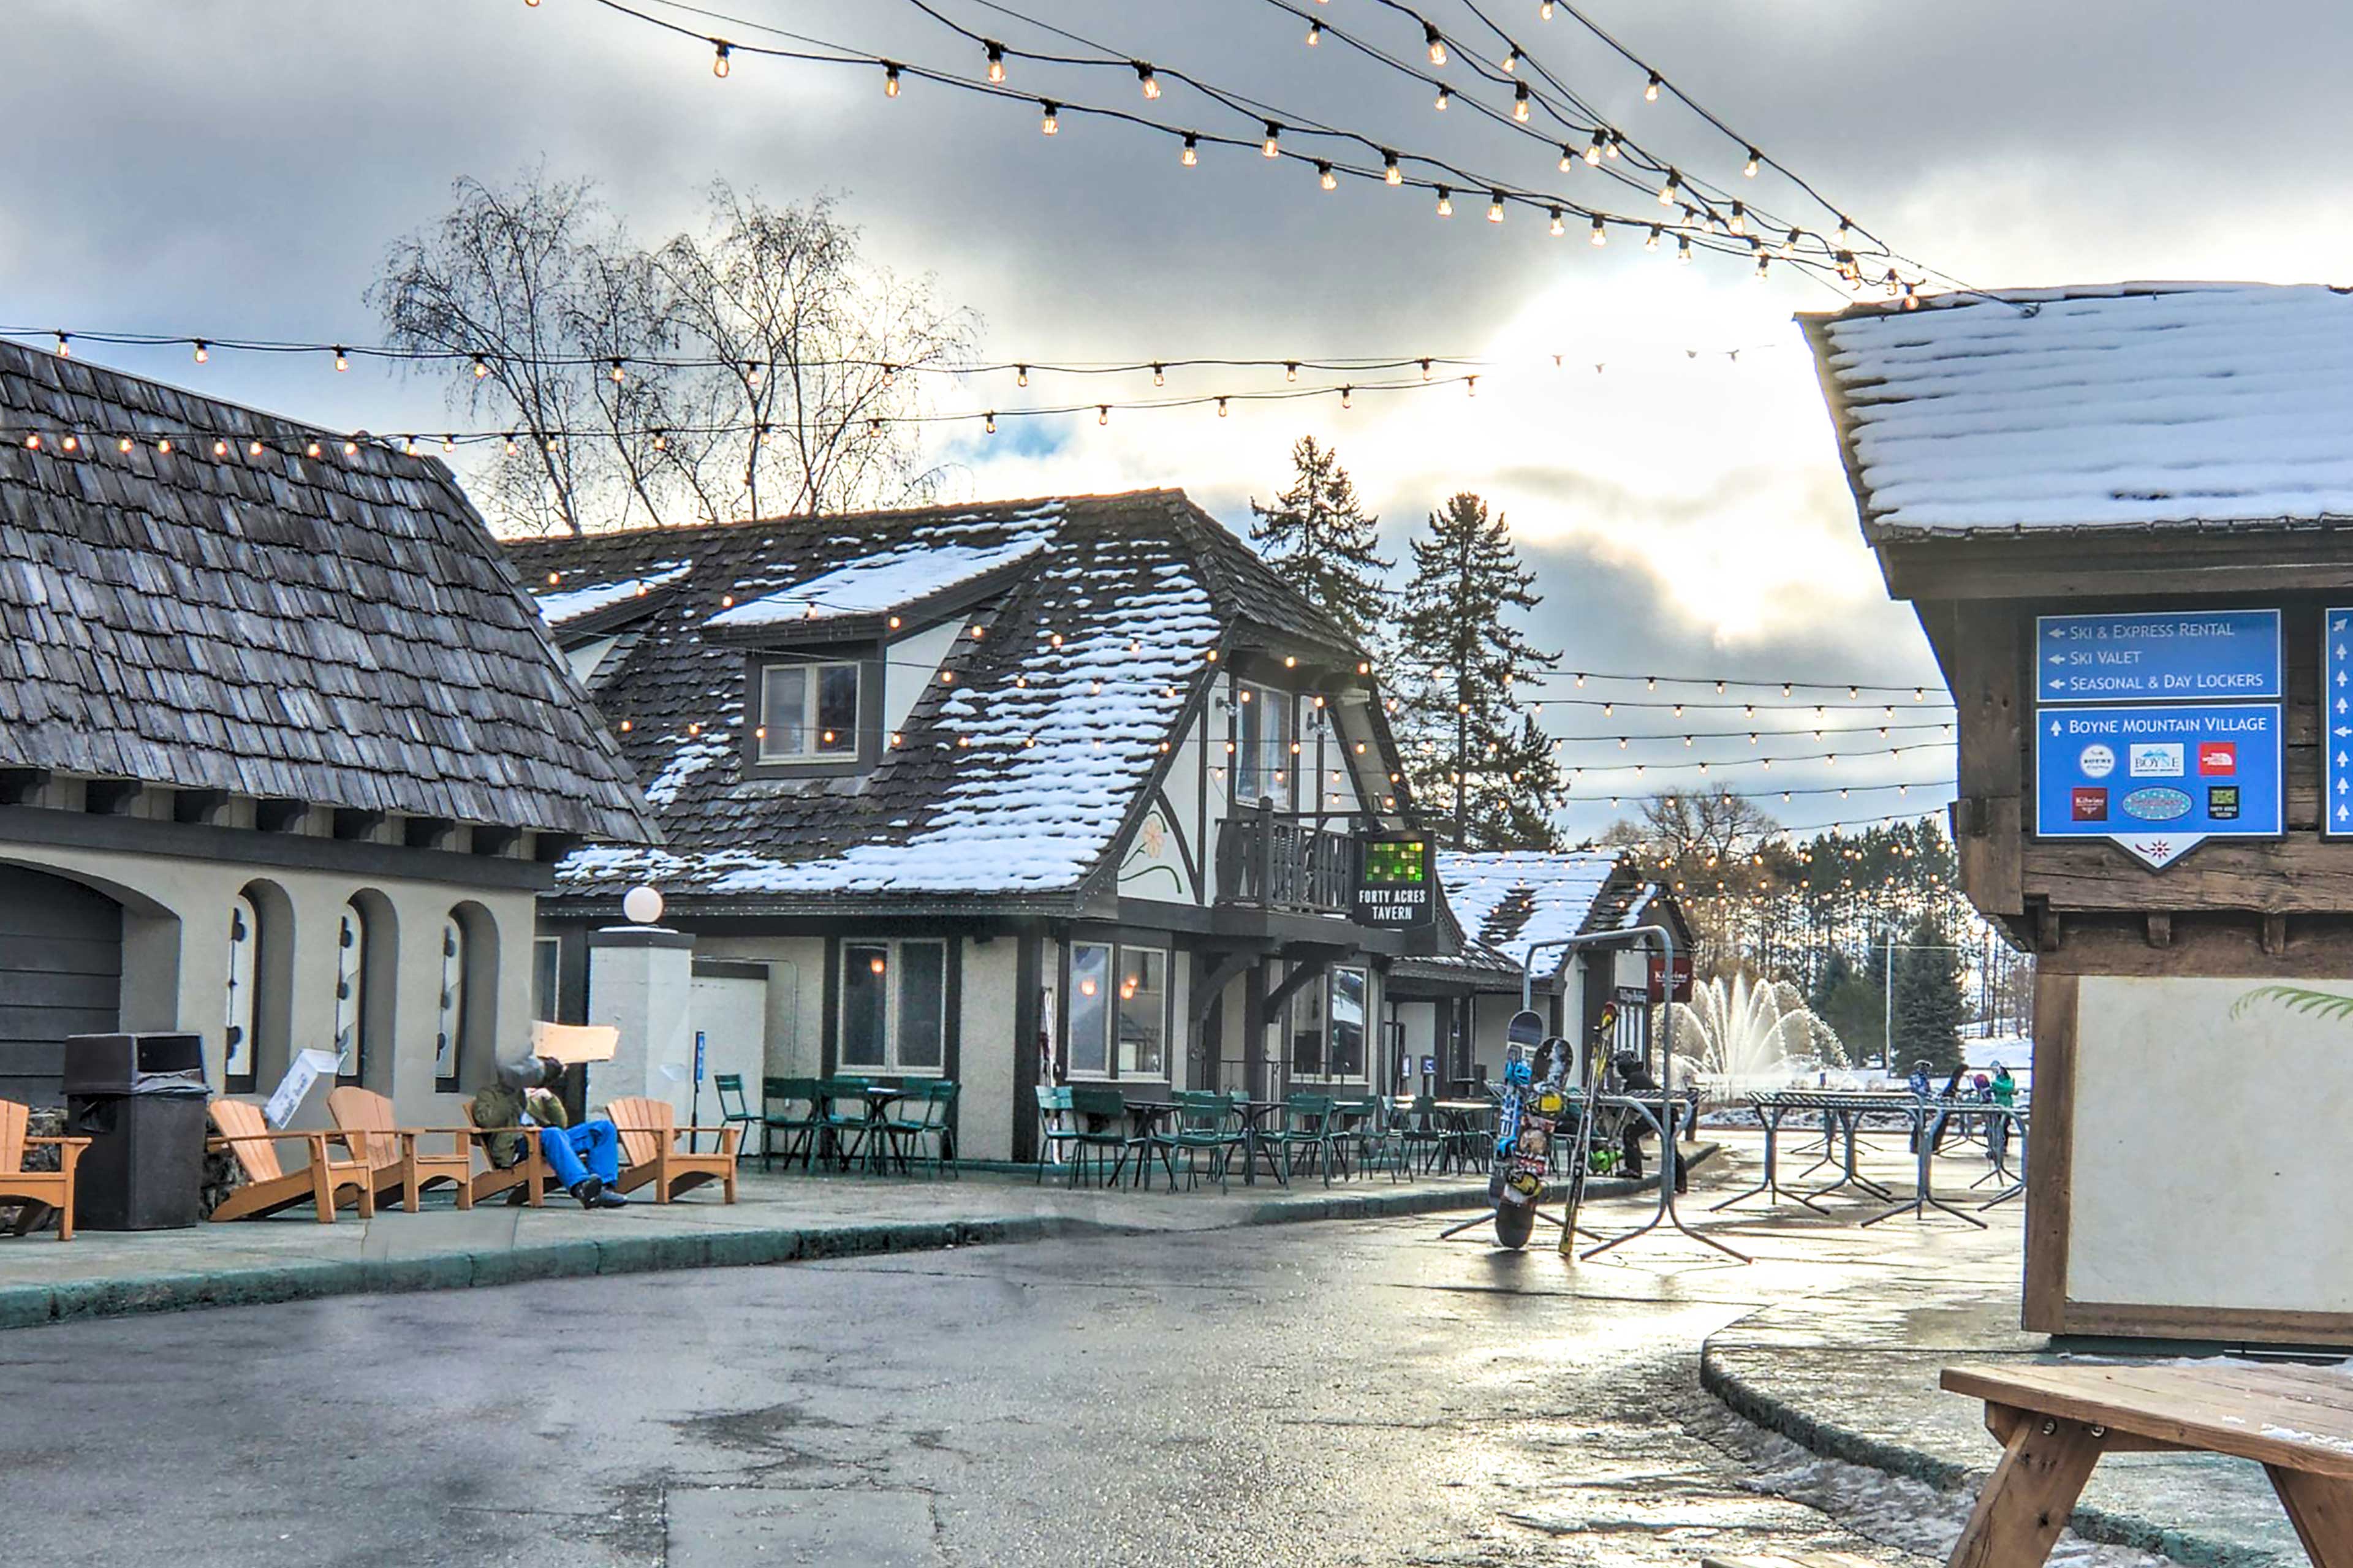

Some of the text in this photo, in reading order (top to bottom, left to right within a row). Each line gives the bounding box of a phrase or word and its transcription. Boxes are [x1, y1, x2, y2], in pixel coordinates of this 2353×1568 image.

[2070, 622, 2234, 640] SKI & EXPRESS RENTAL
[2070, 650, 2142, 665] SKI VALET
[2070, 673, 2263, 691] SEASONAL & DAY LOCKERS
[2069, 717, 2267, 733] BOYNE MOUNTAIN VILLAGE
[2135, 757, 2180, 768] BOYNE
[1359, 889, 1426, 903] FORTY ACRES
[1373, 906, 1412, 920] TAVERN
